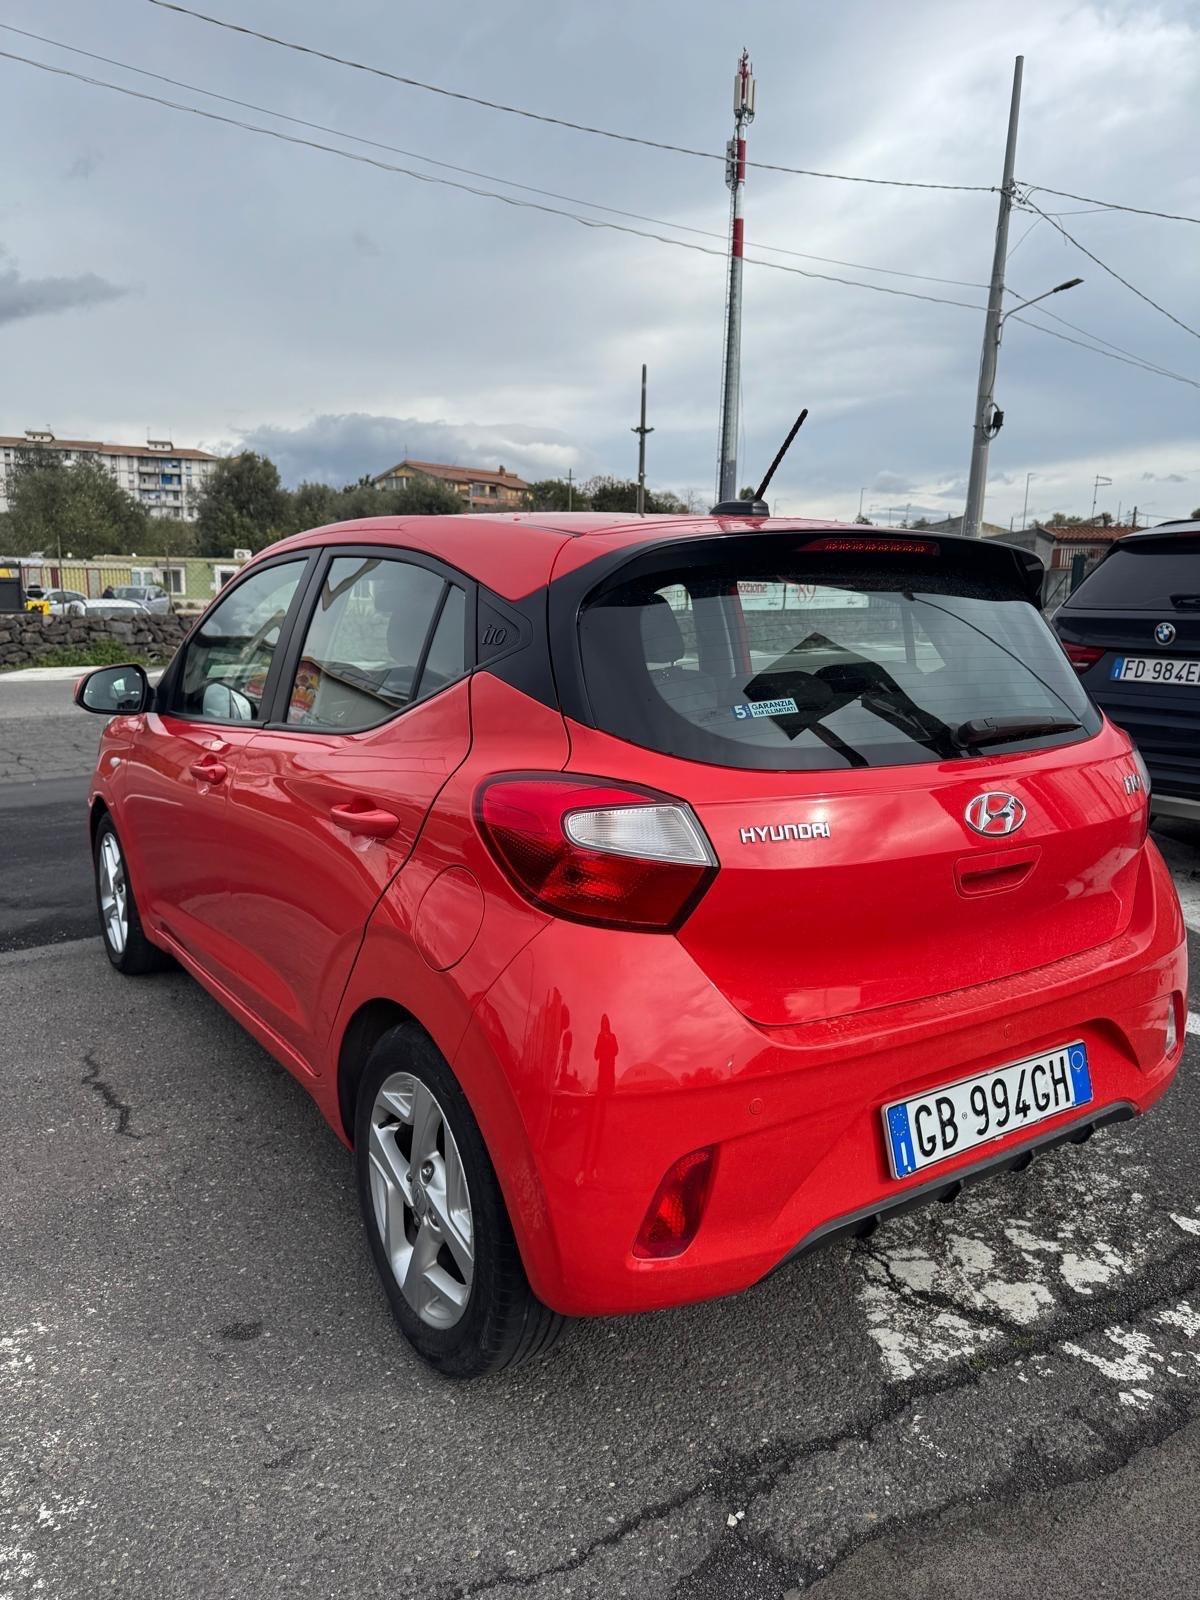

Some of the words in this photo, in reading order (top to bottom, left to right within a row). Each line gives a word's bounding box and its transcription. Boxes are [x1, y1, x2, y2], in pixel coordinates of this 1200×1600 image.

[481, 624, 507, 645] i10
[1123, 660, 1146, 679] FD
[1152, 661, 1200, 683] 984E
[734, 705, 747, 719] 5
[751, 700, 794, 710] GARANZIA
[740, 822, 831, 844] HYUNDAI
[914, 1096, 959, 1158] GB
[969, 1056, 1071, 1136] 994GH
